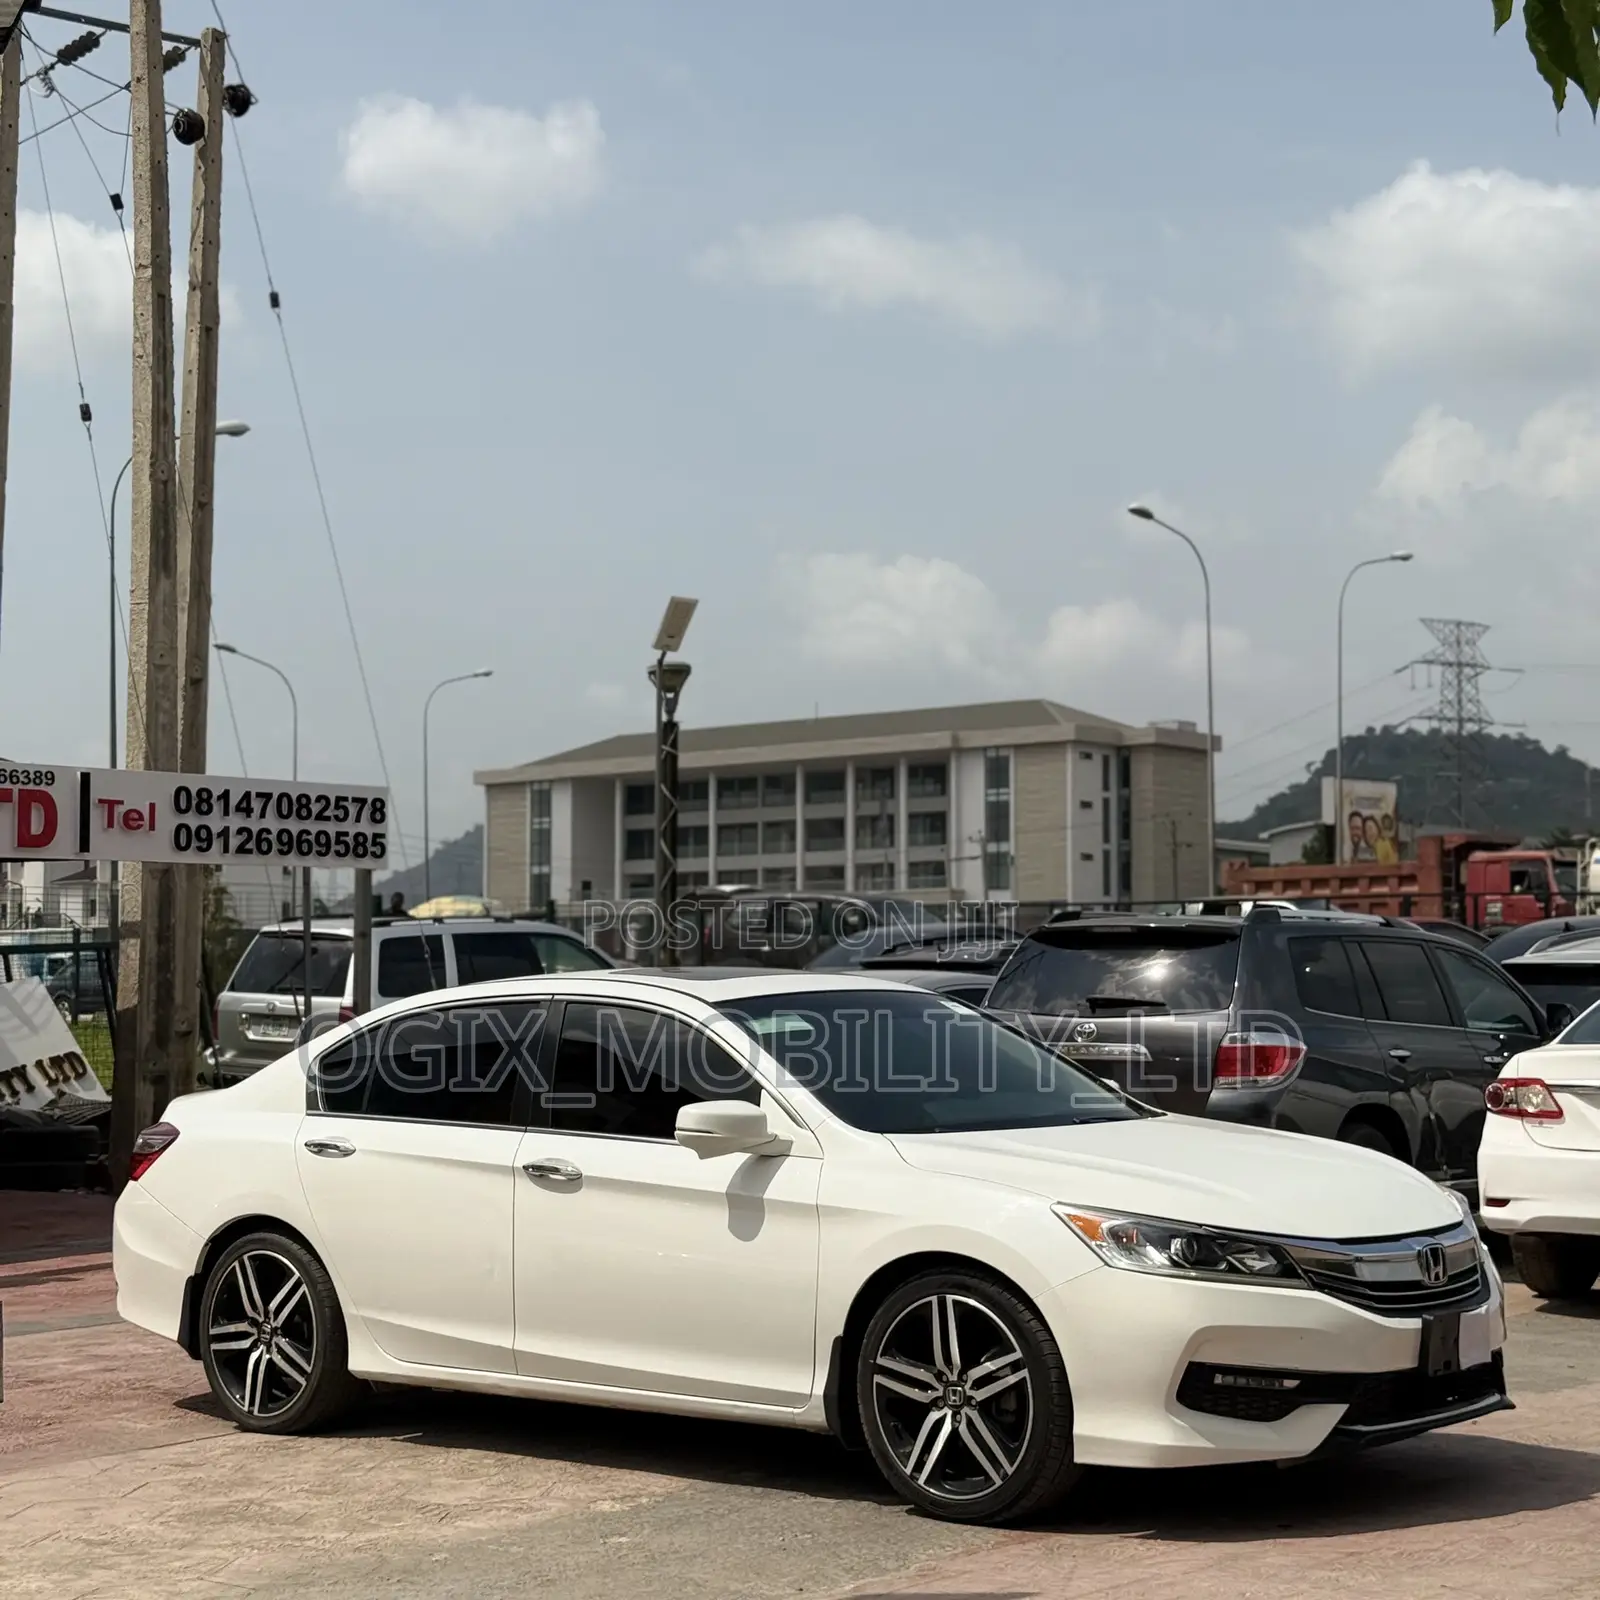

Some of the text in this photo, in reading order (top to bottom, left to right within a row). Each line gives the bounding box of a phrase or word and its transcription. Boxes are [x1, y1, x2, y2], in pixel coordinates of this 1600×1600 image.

[98, 798, 156, 831] Tel
[173, 785, 386, 824] 08147082578
[173, 823, 386, 859] 09126969585
[35, 1051, 87, 1087] LTD
